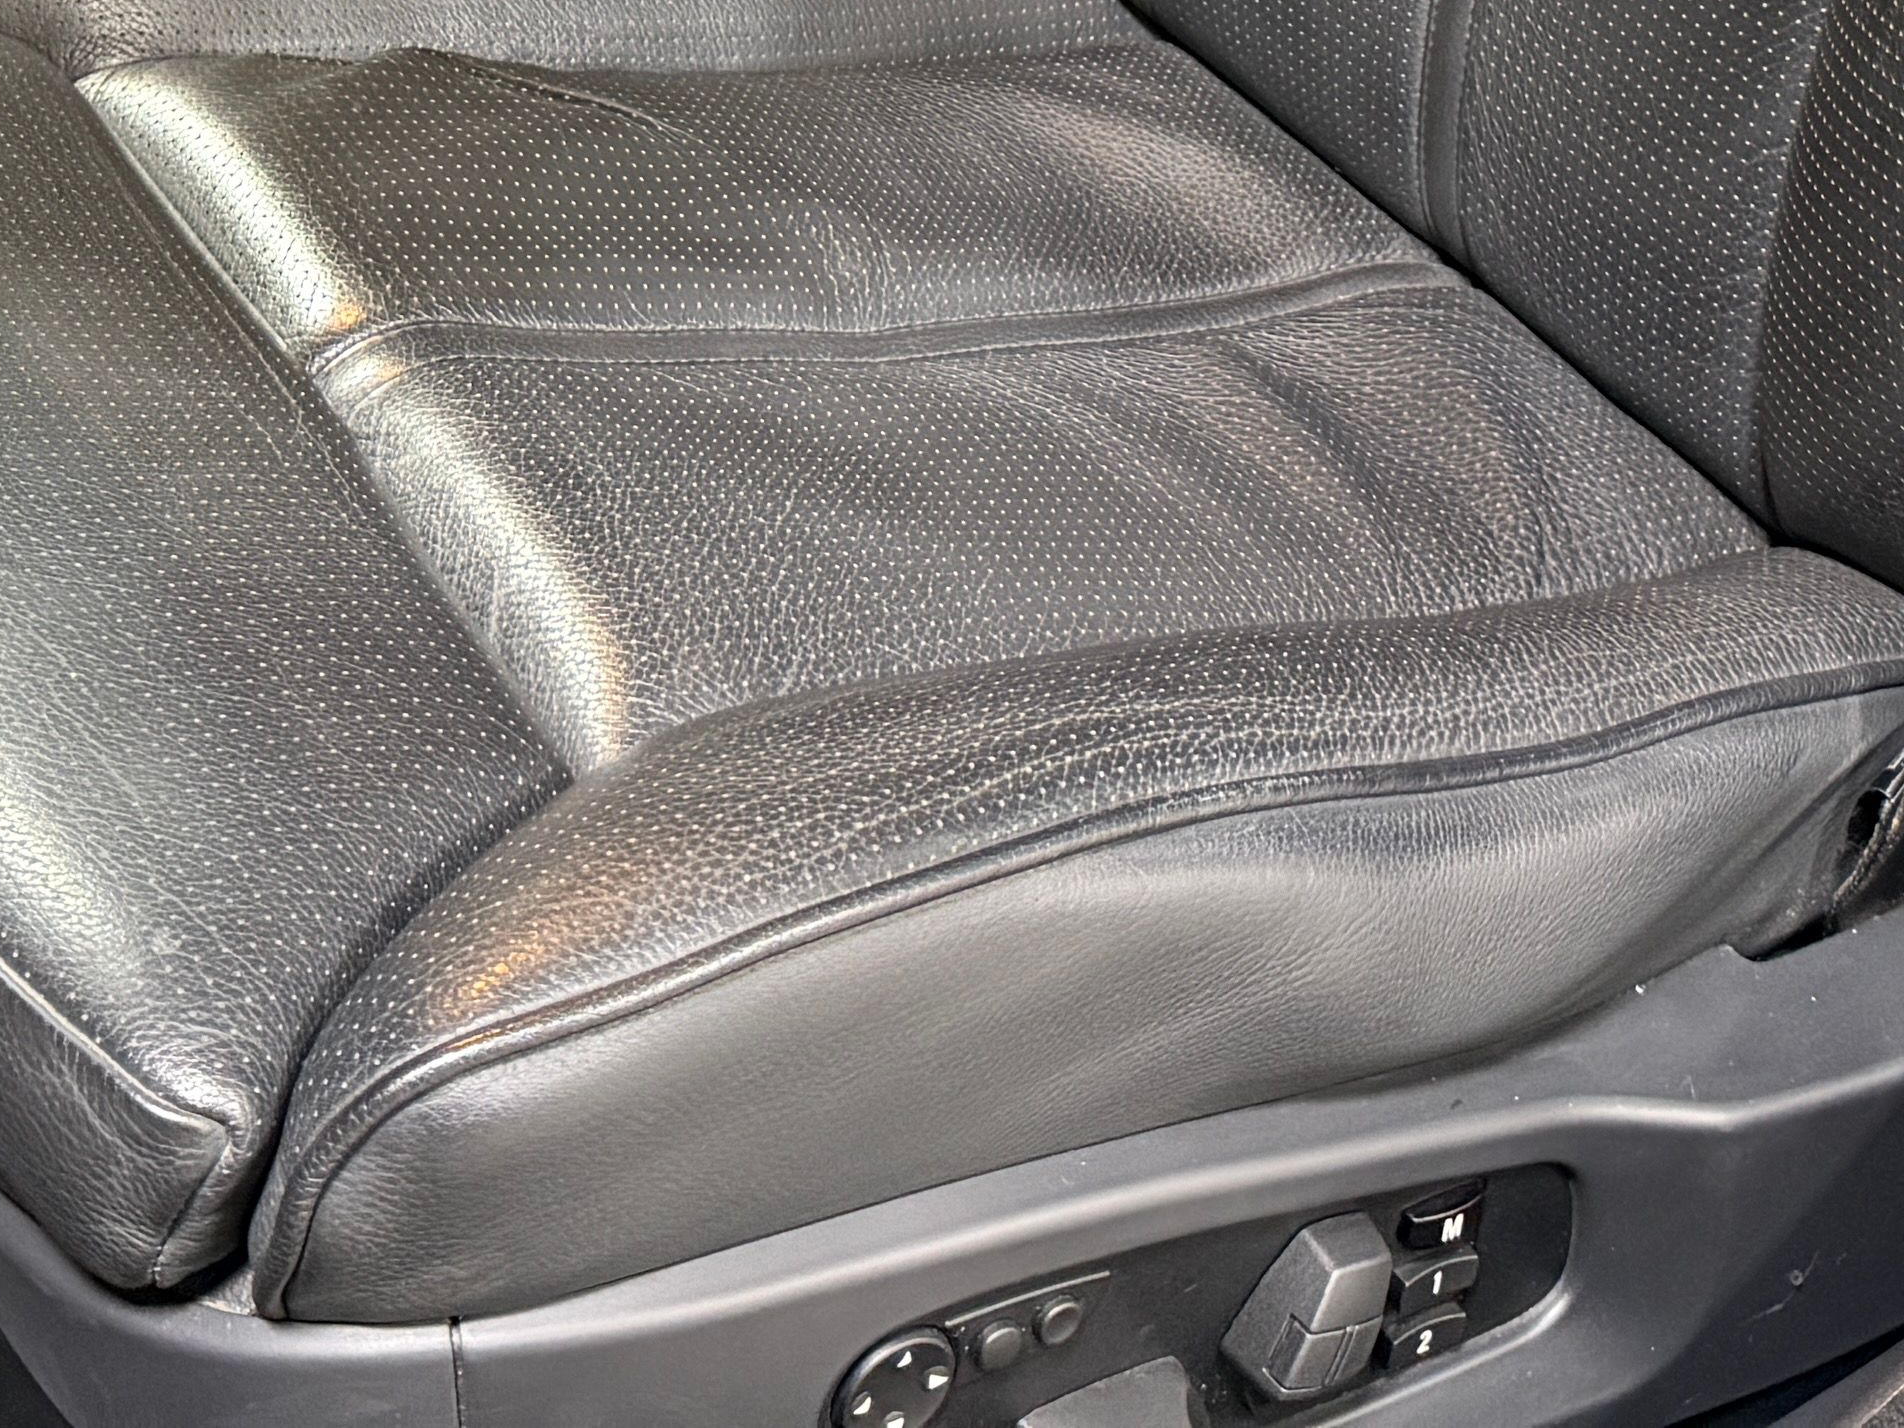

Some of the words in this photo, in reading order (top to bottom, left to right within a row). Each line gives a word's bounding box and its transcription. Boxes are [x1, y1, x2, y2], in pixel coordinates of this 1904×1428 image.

[1441, 1213, 1464, 1243] M
[1432, 1270, 1443, 1295] 1
[1416, 1329, 1433, 1355] 2
